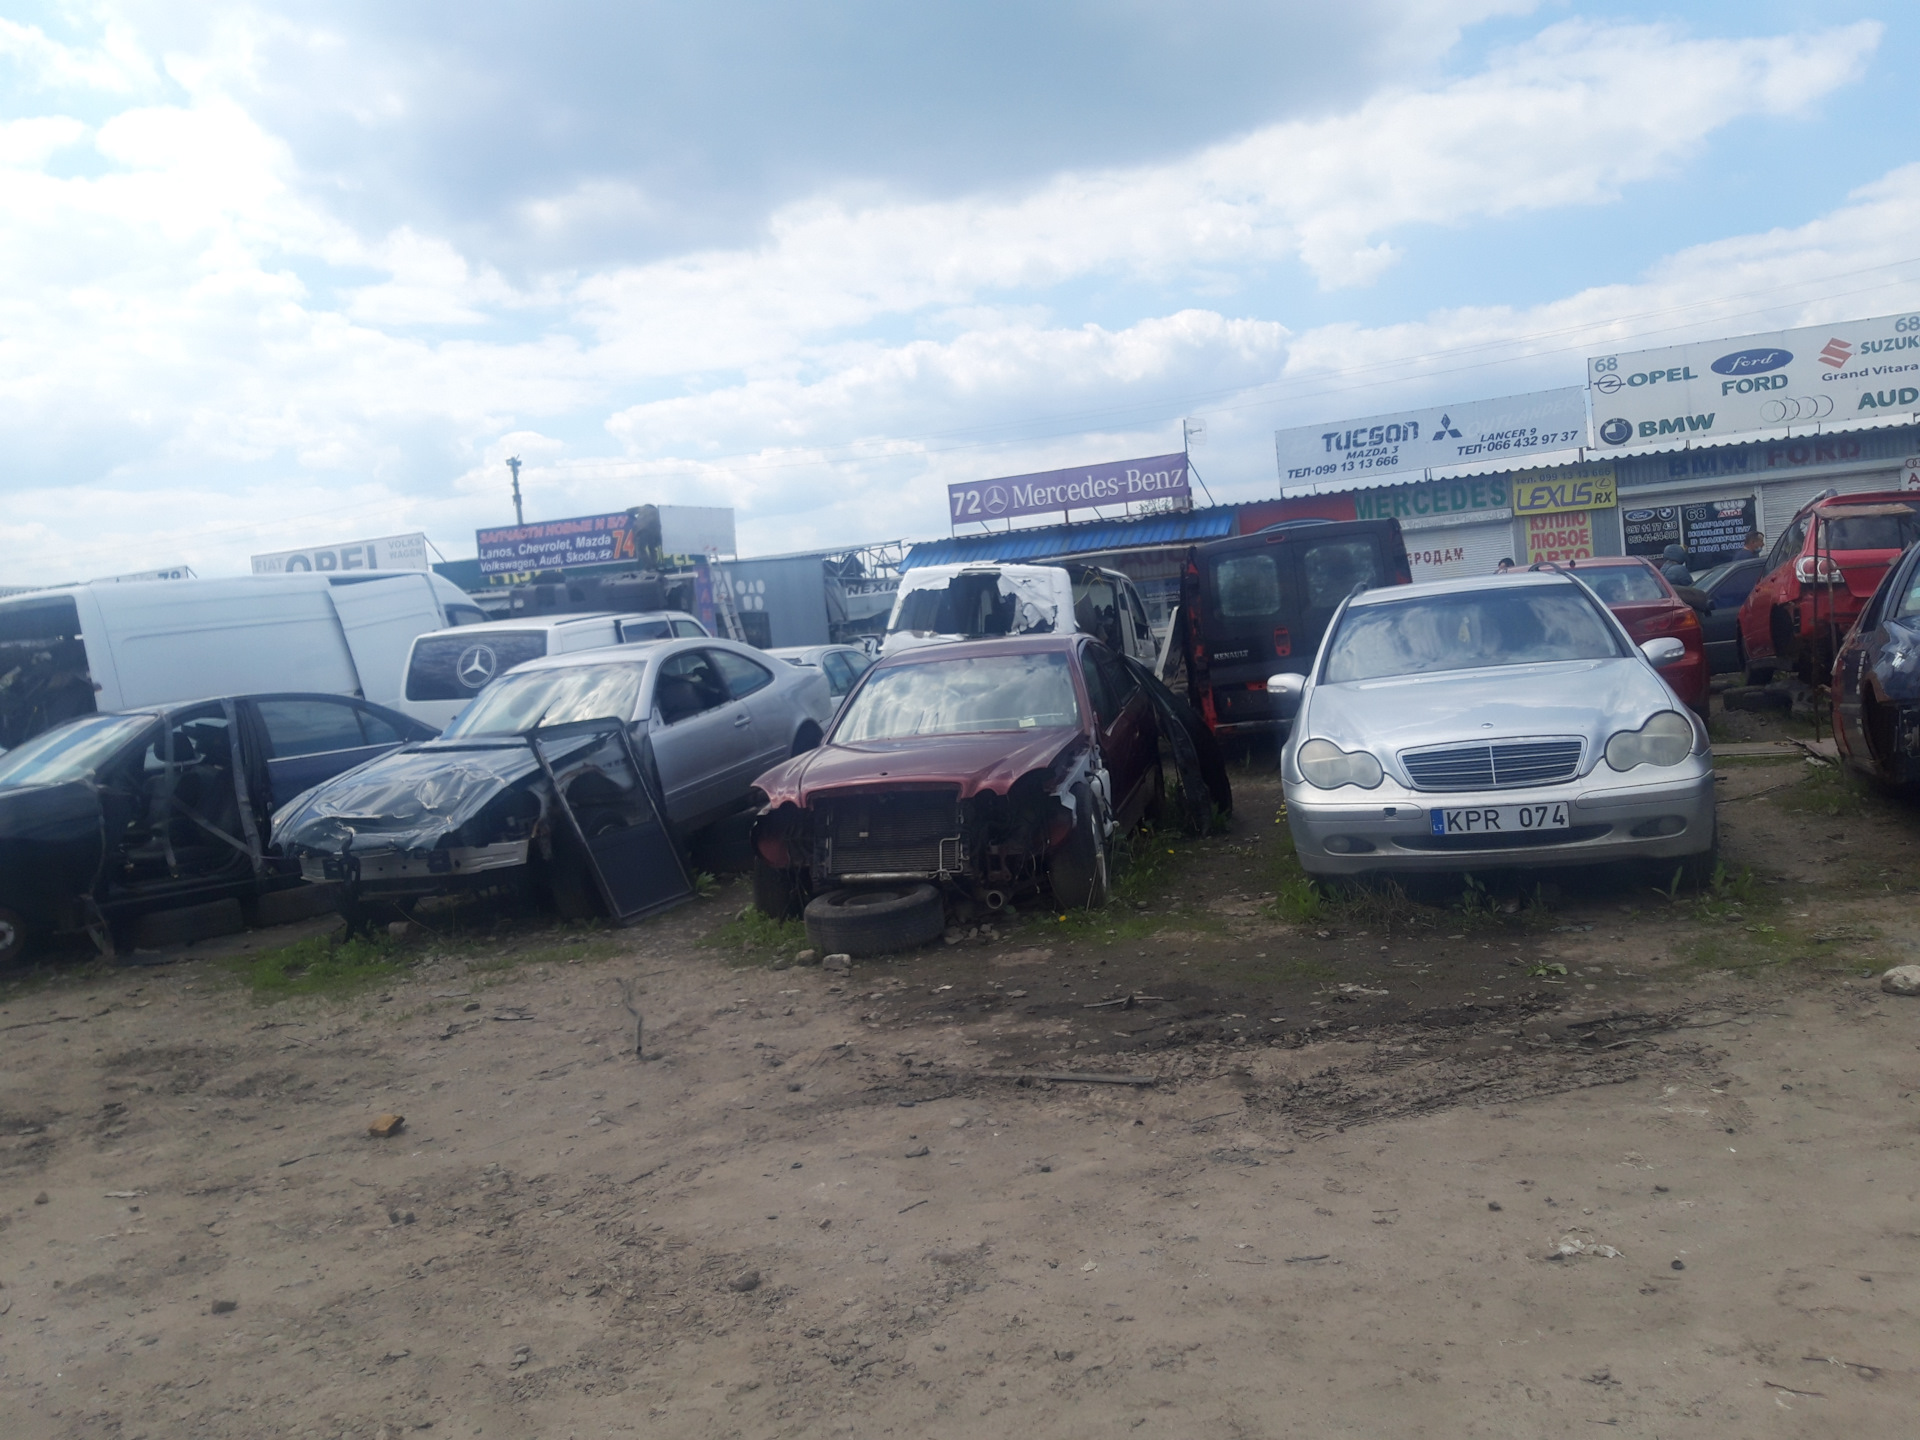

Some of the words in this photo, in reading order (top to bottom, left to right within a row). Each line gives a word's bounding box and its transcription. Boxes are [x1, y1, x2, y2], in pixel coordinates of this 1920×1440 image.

[1894, 316, 1920, 333] 68
[1860, 335, 1920, 355] SUZUK
[1594, 357, 1618, 373] 68
[1821, 367, 1869, 381] Grand
[1872, 363, 1919, 375] Vitara
[1626, 366, 1698, 388] OPEL
[1721, 374, 1788, 397] FORD
[1857, 387, 1920, 410] AUD
[1480, 428, 1527, 442] LANCER
[1530, 427, 1537, 436] 9
[1638, 412, 1716, 438] BMW
[1321, 421, 1419, 453] TUCSON
[1513, 436, 1538, 448] 432
[1541, 433, 1558, 445] 97
[1560, 430, 1579, 442] 37
[1346, 447, 1388, 460] MAZDA
[1391, 445, 1399, 454] 3
[1767, 439, 1861, 467] FORD
[1340, 461, 1355, 472] 13
[1358, 458, 1373, 470] 13
[1375, 455, 1399, 467] 666
[1668, 450, 1750, 476] BMW
[1540, 473, 1558, 482] 099
[952, 490, 982, 517] 72
[1012, 467, 1184, 509] Mercedes-Benz
[1354, 479, 1507, 520] MERCEDES
[1517, 482, 1593, 511] LEXUS
[1594, 491, 1613, 504] RX
[1530, 511, 1587, 531] КУПЛЮ
[1686, 508, 1706, 520] 68
[1690, 518, 1744, 530] ЗАПЧАСТИ
[479, 524, 543, 544] ЗАПЧАСТИ
[545, 518, 593, 536] НОВЫЕ
[1530, 528, 1590, 550] ЛЮБОЕ
[1687, 528, 1724, 538] НОВЫЕ
[388, 538, 422, 550] VOLKS
[518, 537, 572, 556] Chevrolet,
[575, 535, 611, 548] Mazda
[612, 529, 635, 559] 74
[1721, 541, 1745, 551] ЗАКА
[254, 557, 284, 573] FIAT
[1213, 649, 1249, 660] RENAULT
[1446, 809, 1501, 832] KPR
[1519, 805, 1566, 828] 074
